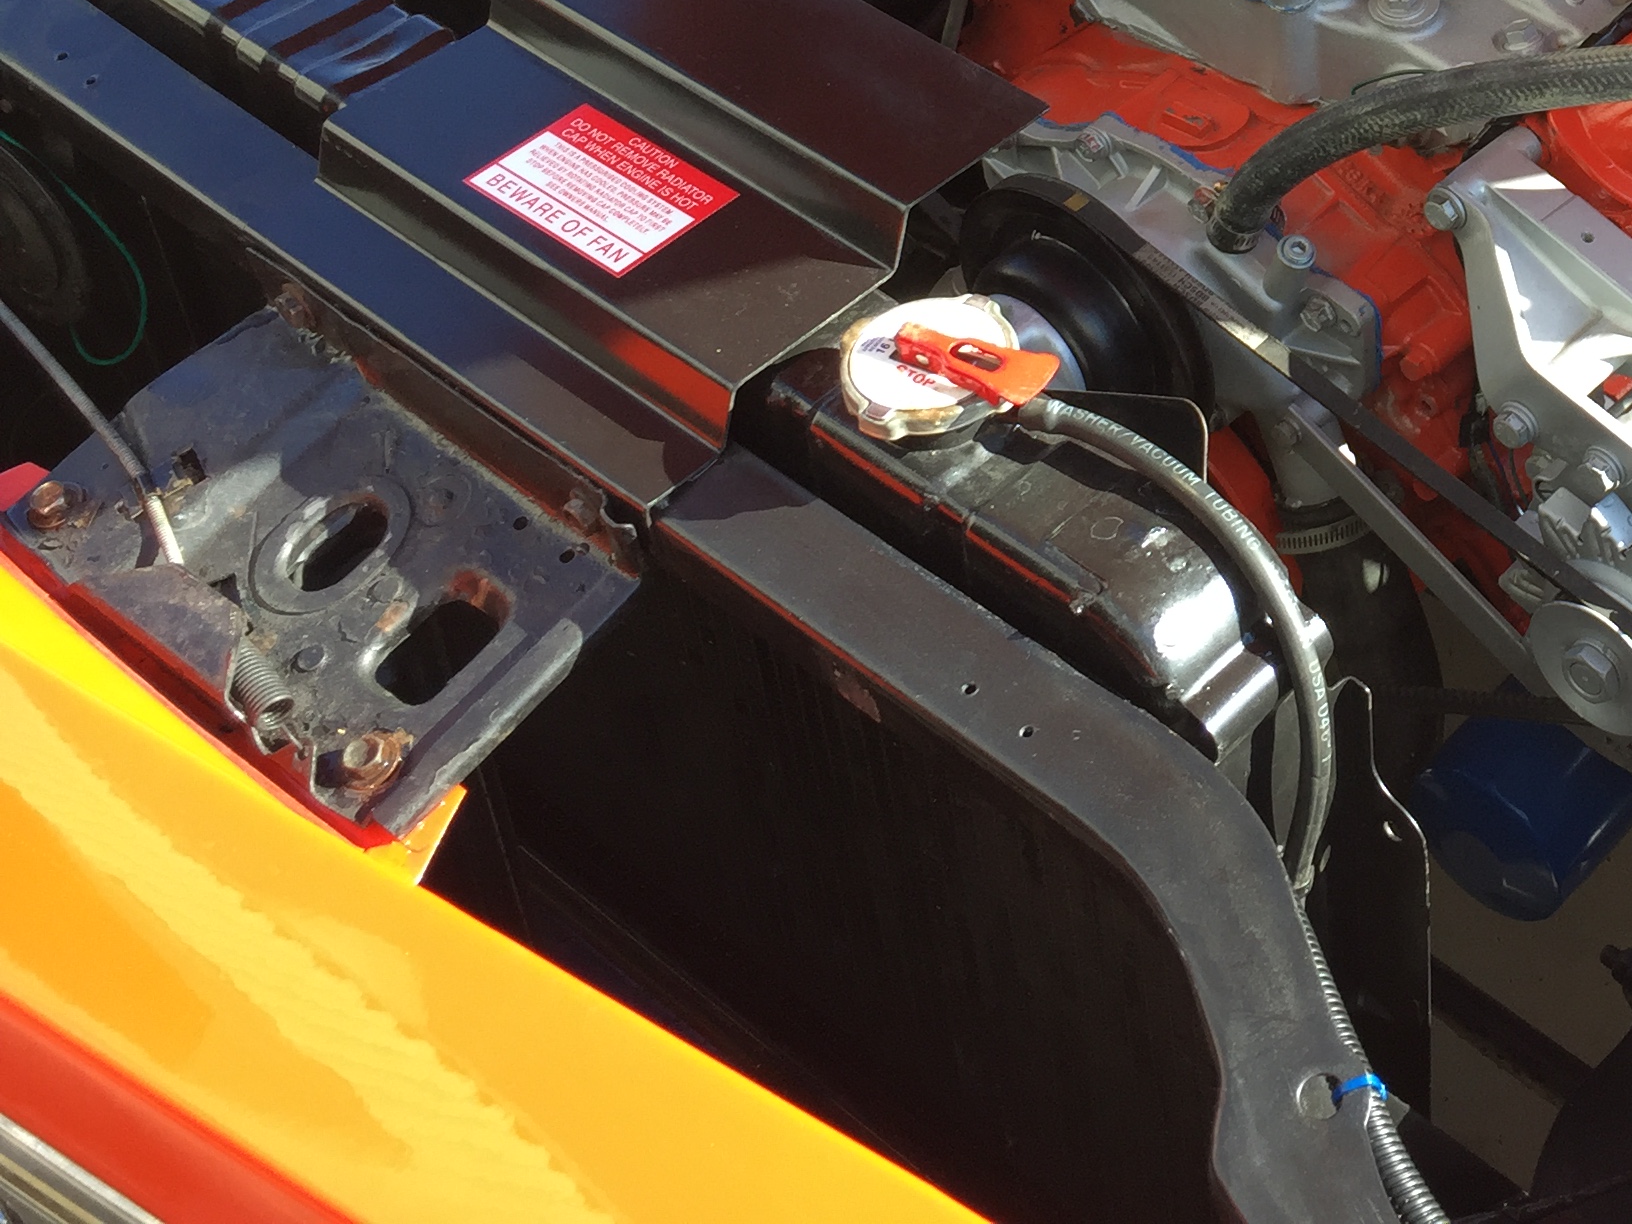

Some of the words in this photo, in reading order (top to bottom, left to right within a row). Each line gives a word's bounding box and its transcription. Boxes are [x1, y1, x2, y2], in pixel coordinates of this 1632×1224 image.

[559, 127, 589, 145] CAP
[581, 140, 621, 165] WHEN
[614, 160, 662, 189] ENGINE
[655, 185, 675, 197] IS
[667, 192, 698, 211] HOT
[568, 117, 594, 132] DO
[586, 127, 615, 145] NOT
[609, 141, 661, 173] REMOVE
[654, 168, 714, 205] RADIATOR
[626, 136, 680, 168] CAUTION
[484, 172, 566, 223] BEWARE
[557, 218, 593, 240] OF
[585, 235, 630, 263] FAN
[896, 364, 937, 387] STOP
[1046, 397, 1201, 487] WASHER/VACUUM
[1204, 490, 1263, 552] TUBING
[1308, 658, 1326, 702] USA
